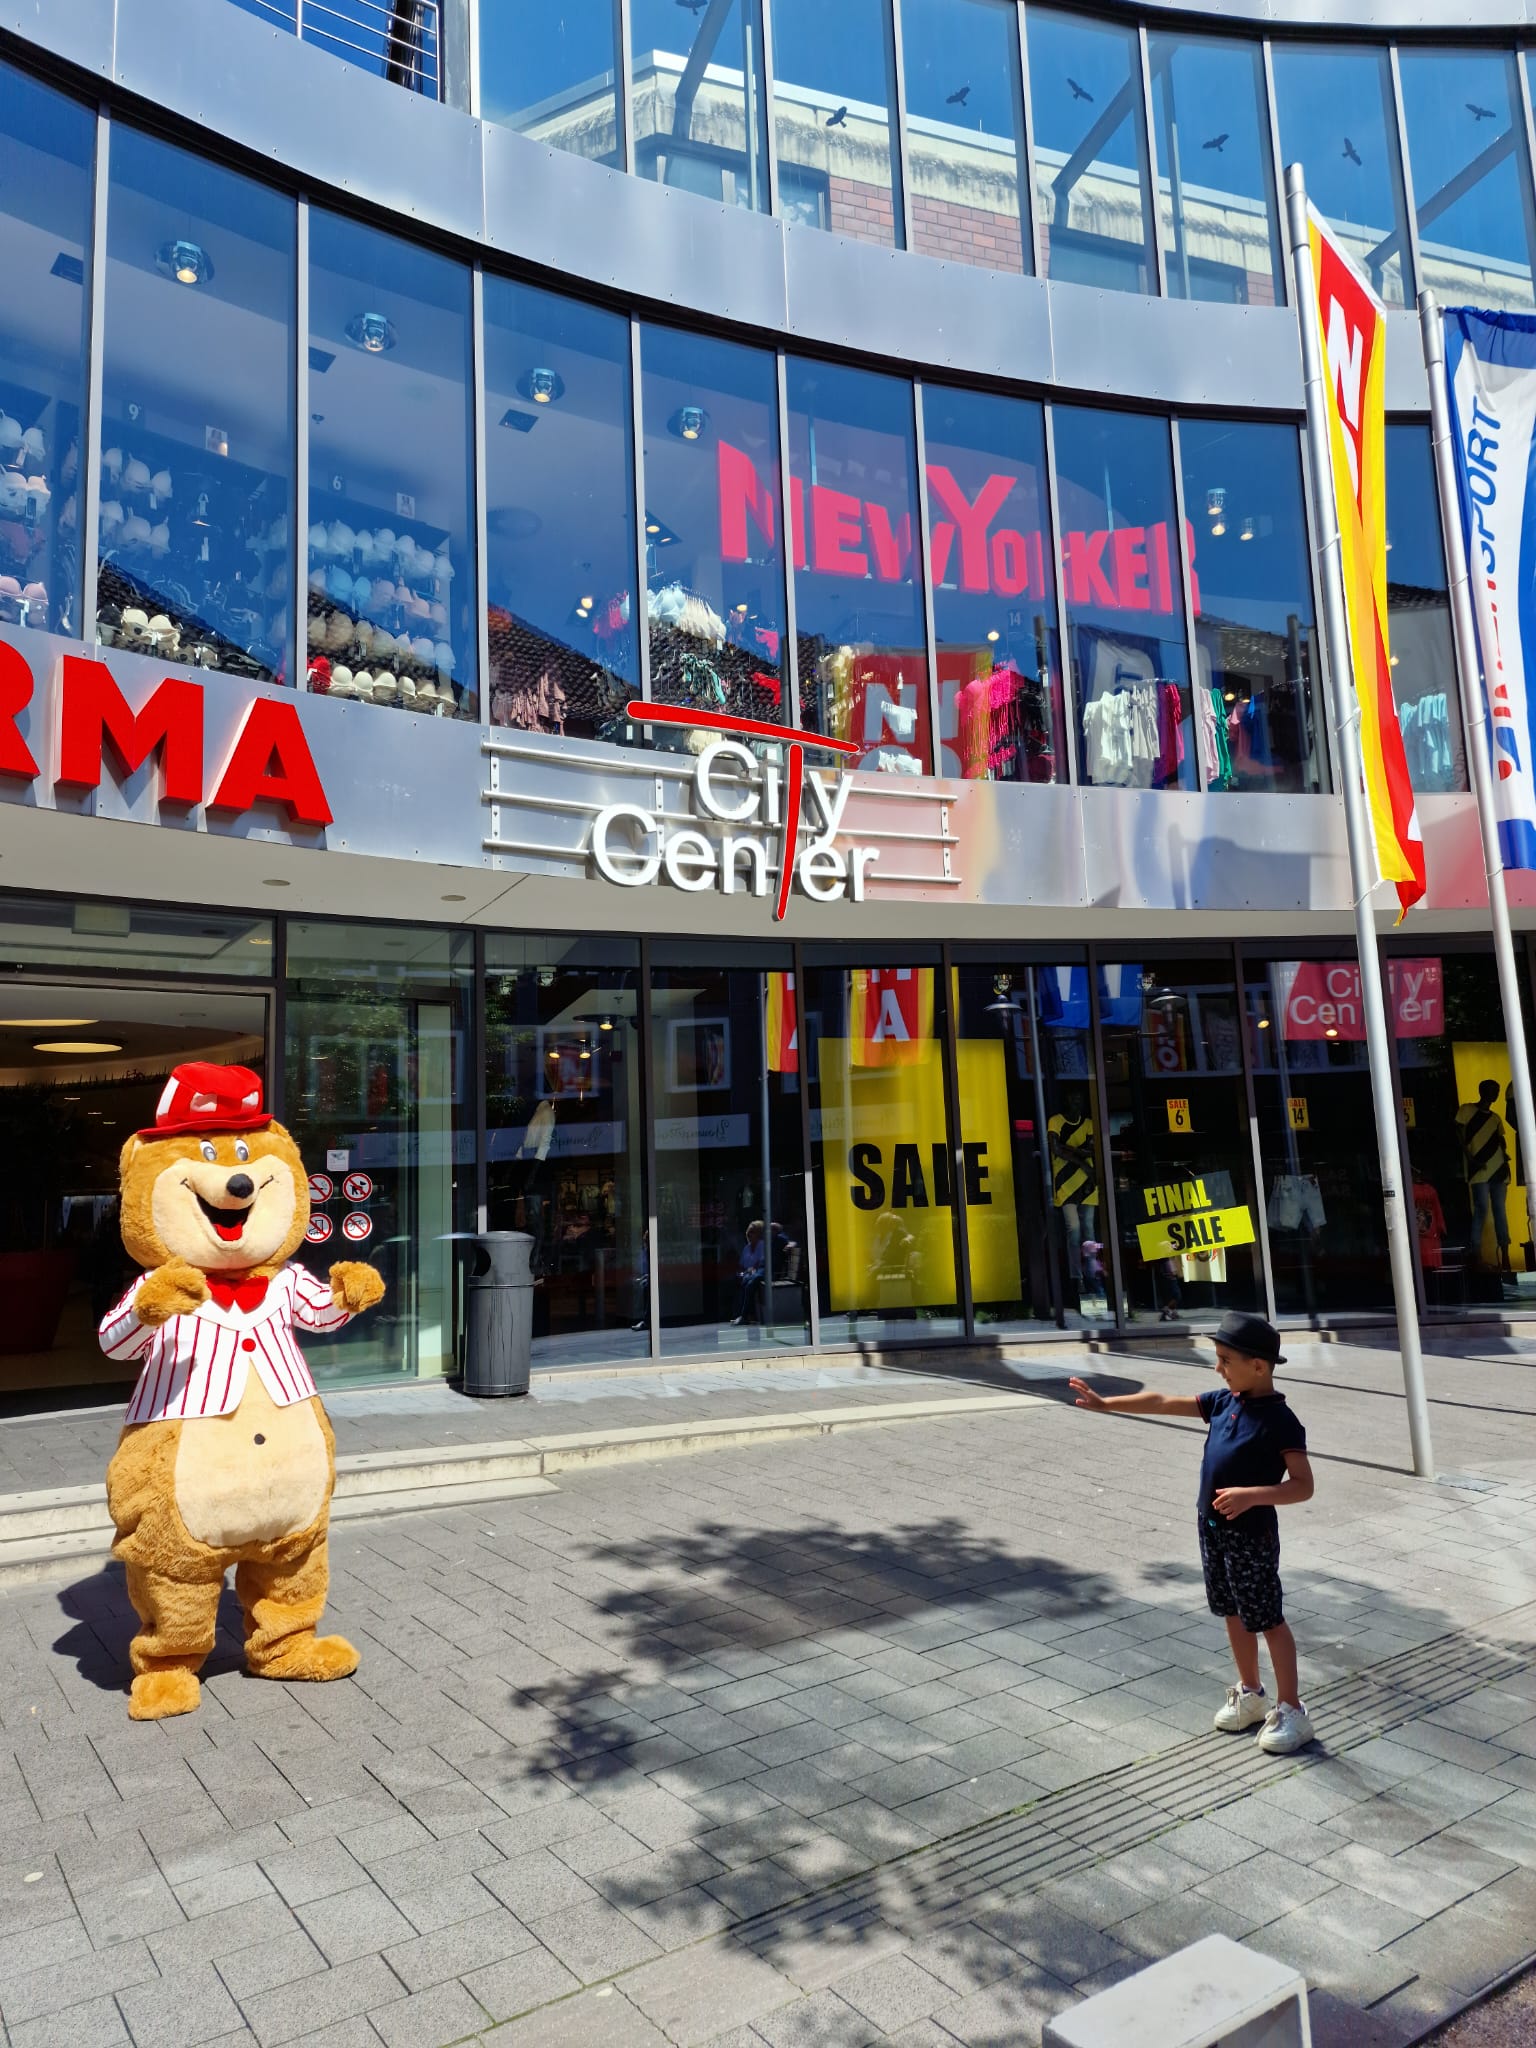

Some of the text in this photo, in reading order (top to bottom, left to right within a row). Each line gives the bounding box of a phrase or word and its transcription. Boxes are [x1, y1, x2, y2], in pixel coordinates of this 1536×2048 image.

[694, 738, 855, 849] City
[591, 805, 880, 914] Center
[1292, 1108, 1304, 1124] 14
[848, 1142, 993, 1211] SALE
[1143, 1179, 1212, 1217] FINAL
[1167, 1215, 1226, 1251] SALE
